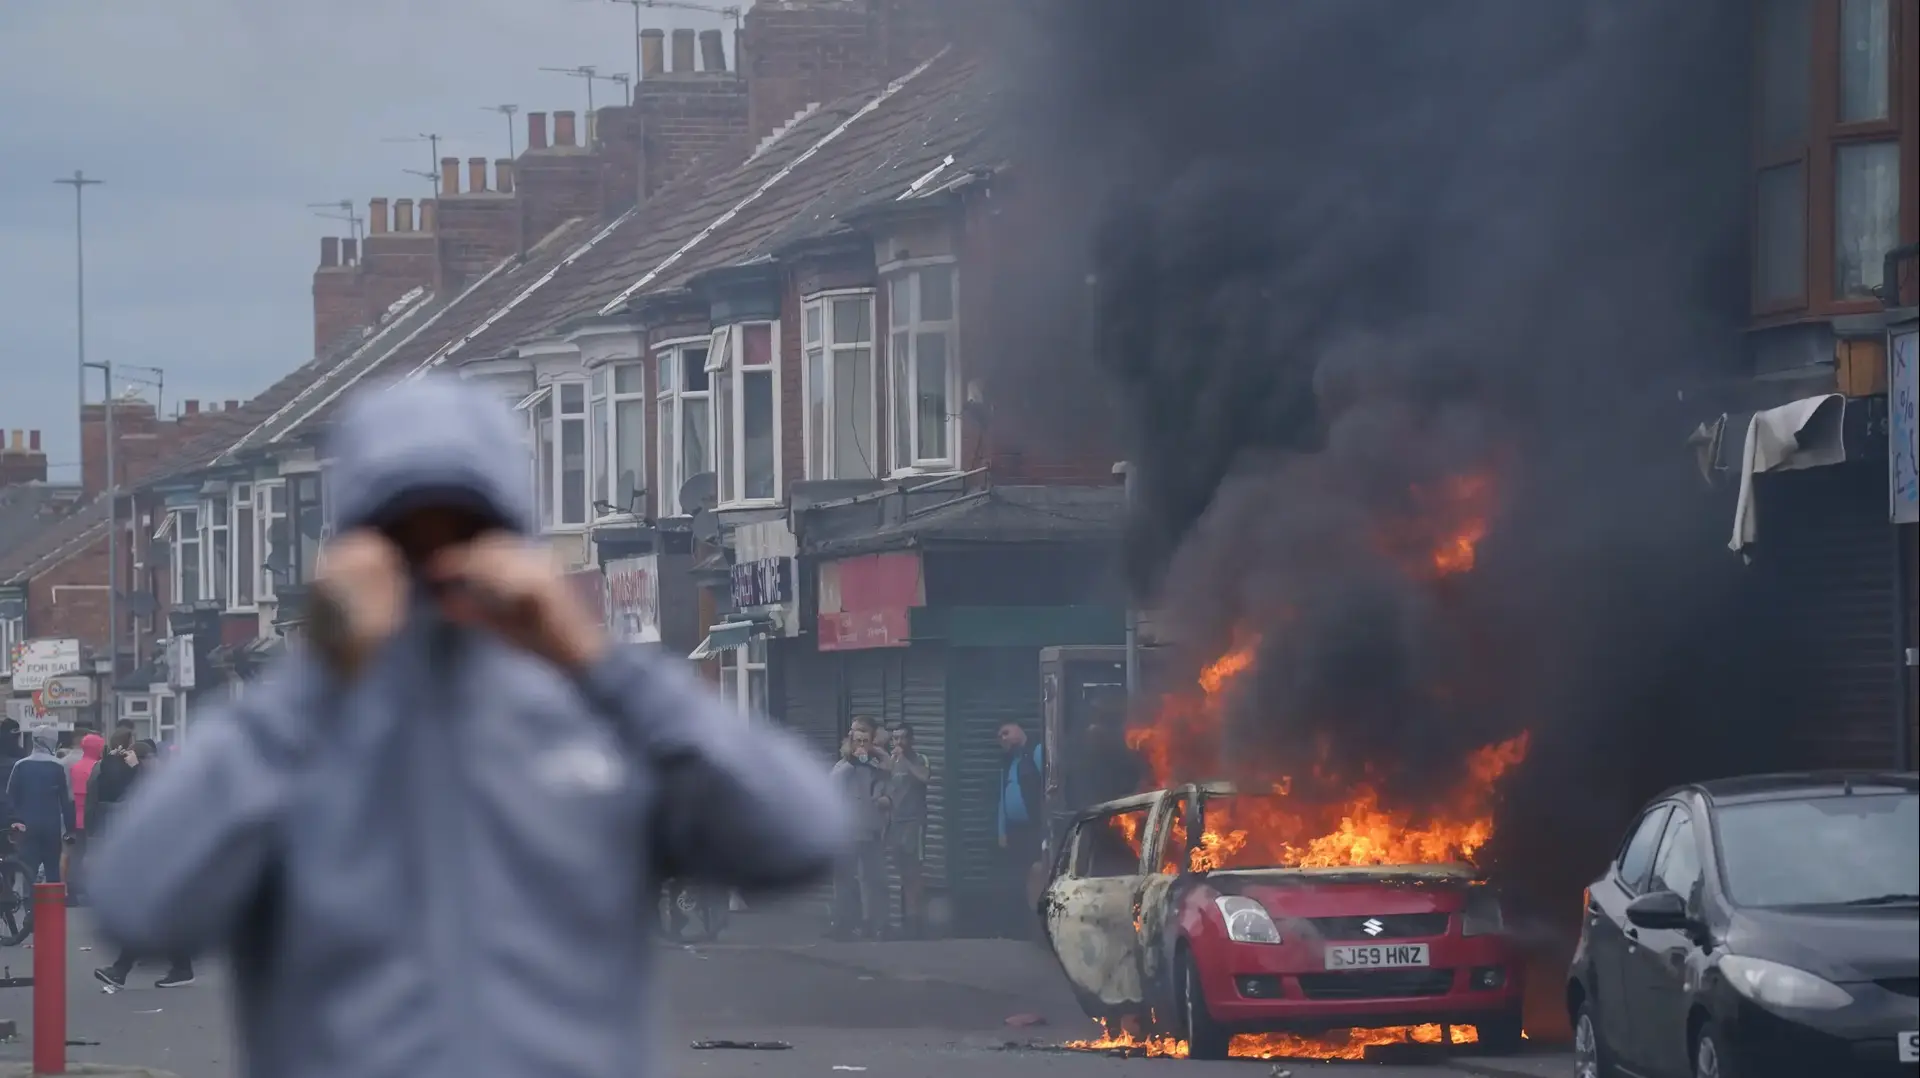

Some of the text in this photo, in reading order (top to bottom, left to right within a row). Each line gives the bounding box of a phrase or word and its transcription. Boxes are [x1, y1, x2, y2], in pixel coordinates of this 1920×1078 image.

[27, 661, 77, 673] FOR SALE
[1333, 946, 1422, 966] SJ59 HNZ
